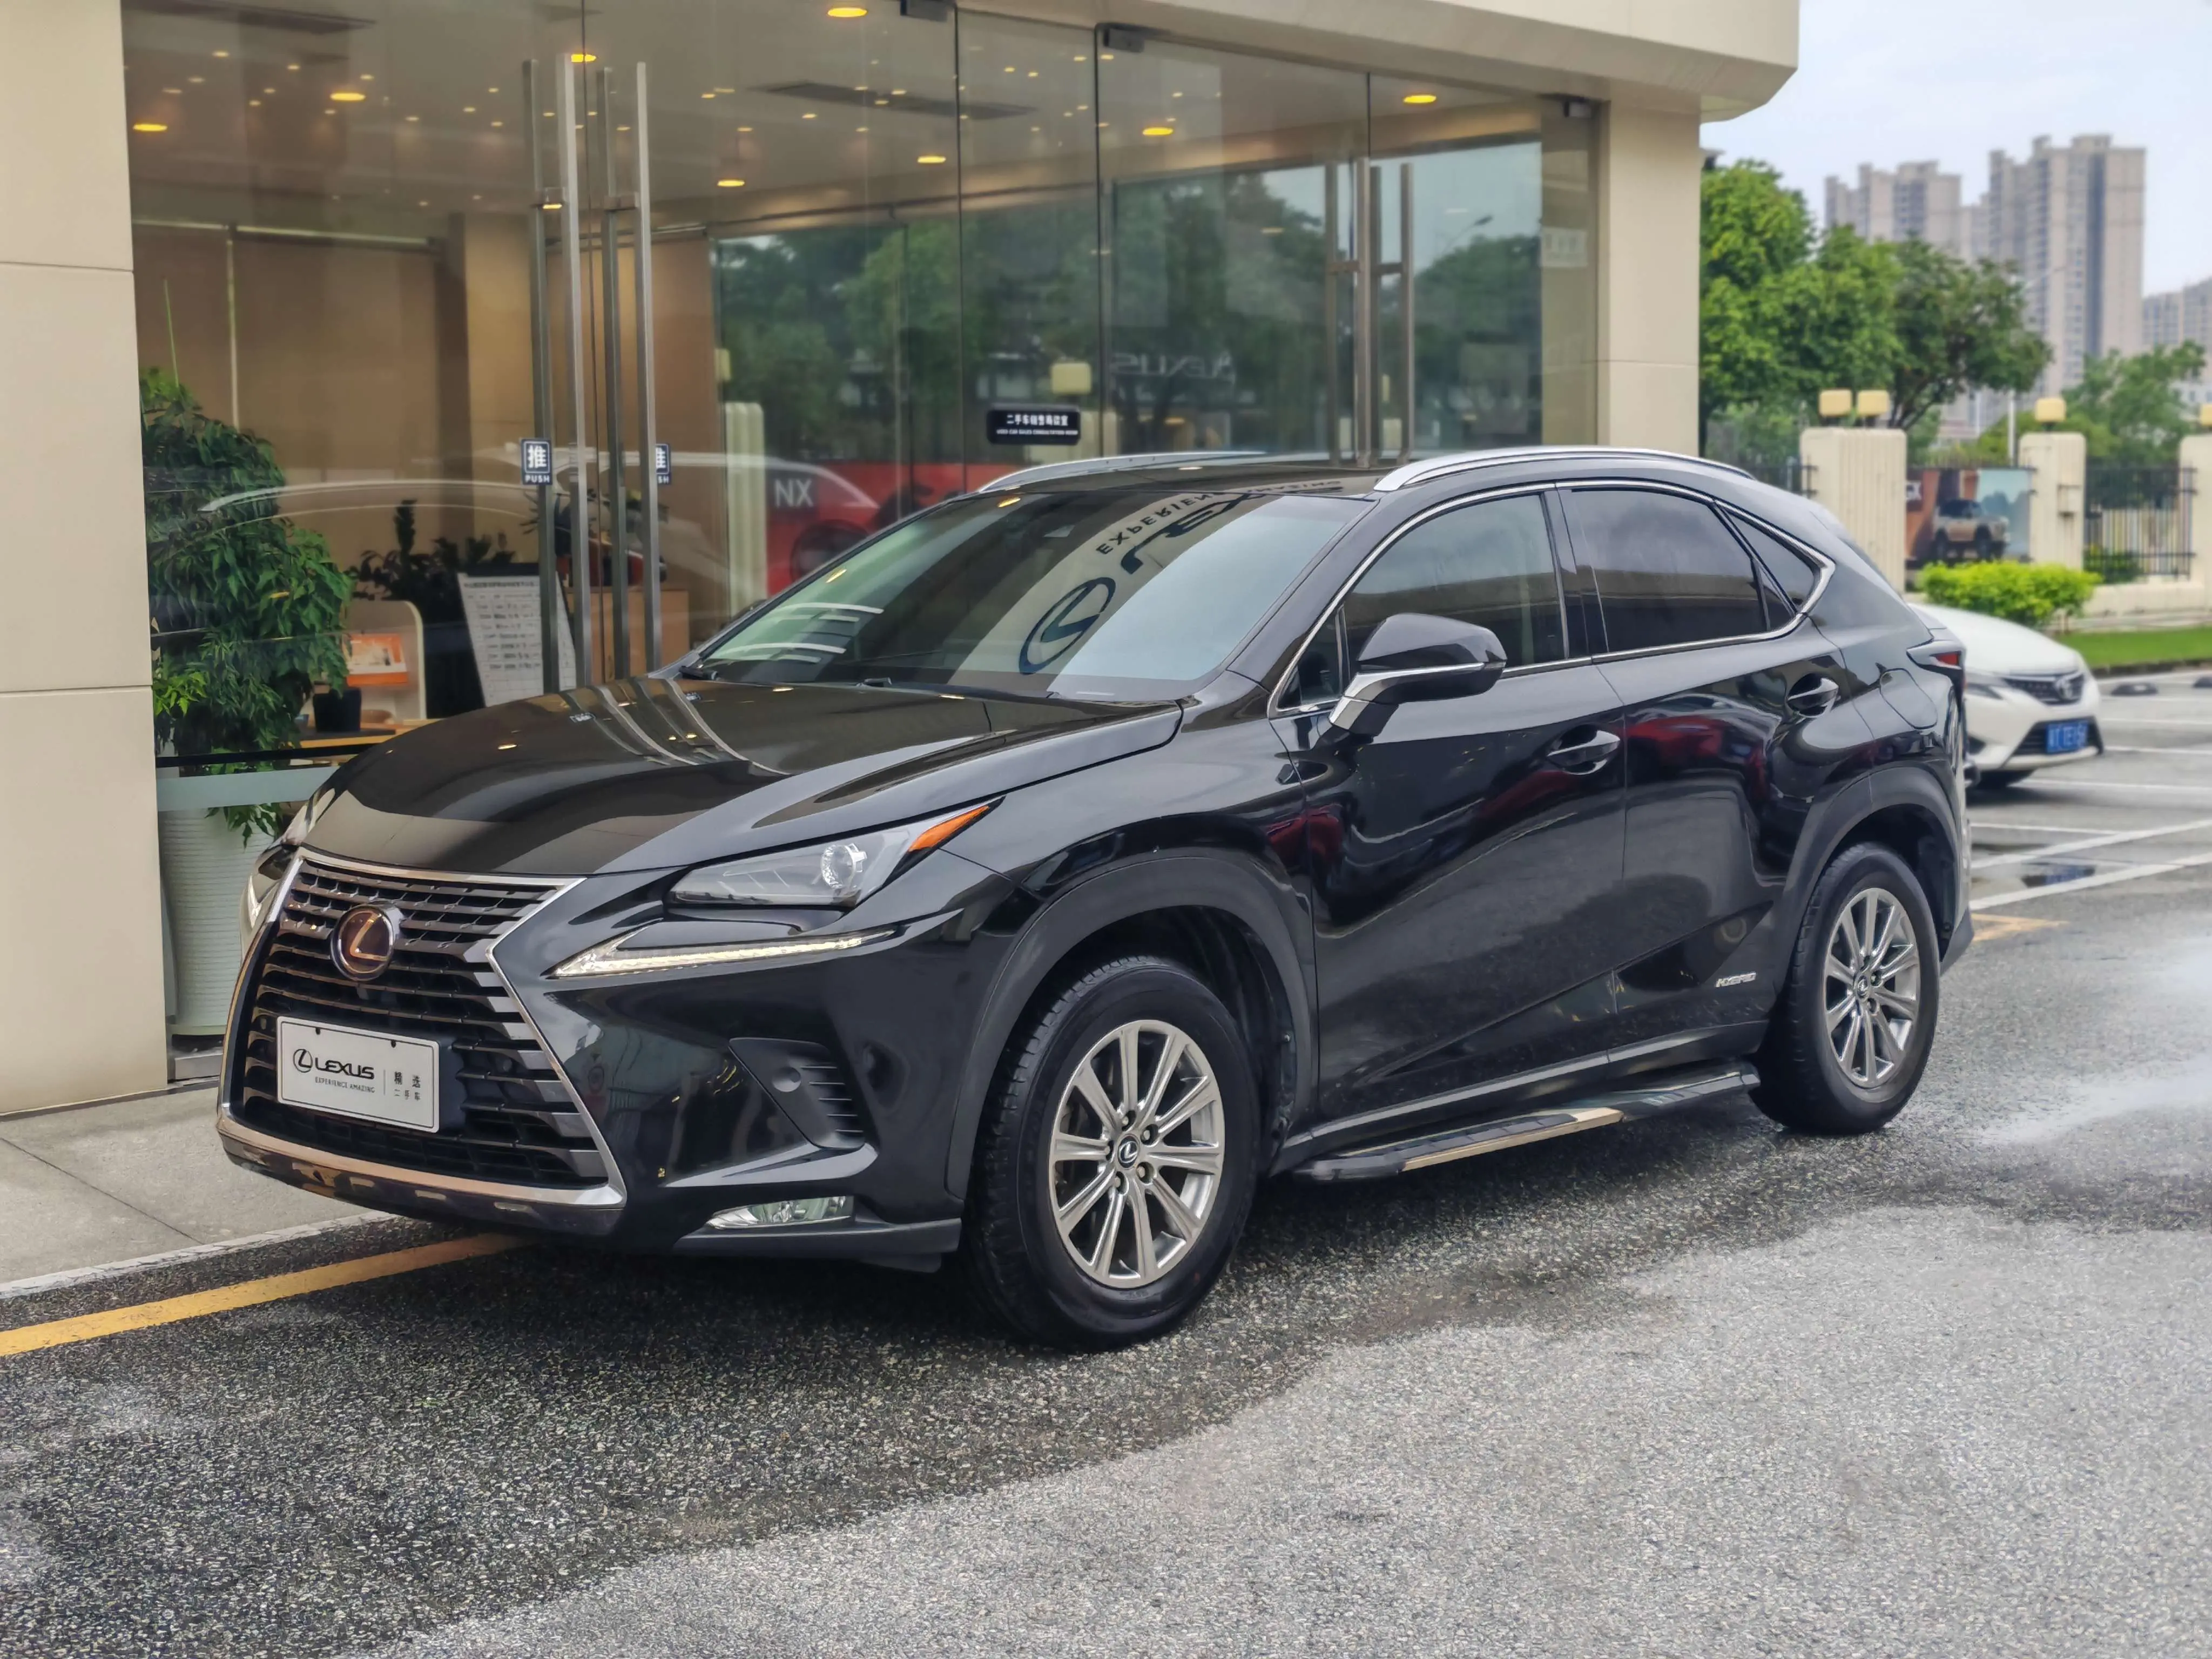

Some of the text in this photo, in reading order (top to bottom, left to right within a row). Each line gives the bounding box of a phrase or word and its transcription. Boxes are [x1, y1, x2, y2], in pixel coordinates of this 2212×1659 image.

[528, 444, 547, 469] 推
[525, 475, 550, 483] PUSH
[658, 475, 669, 484] SH
[773, 478, 814, 507] NX
[315, 1057, 375, 1080] LEXUS
[349, 1084, 376, 1093] AMAZING
